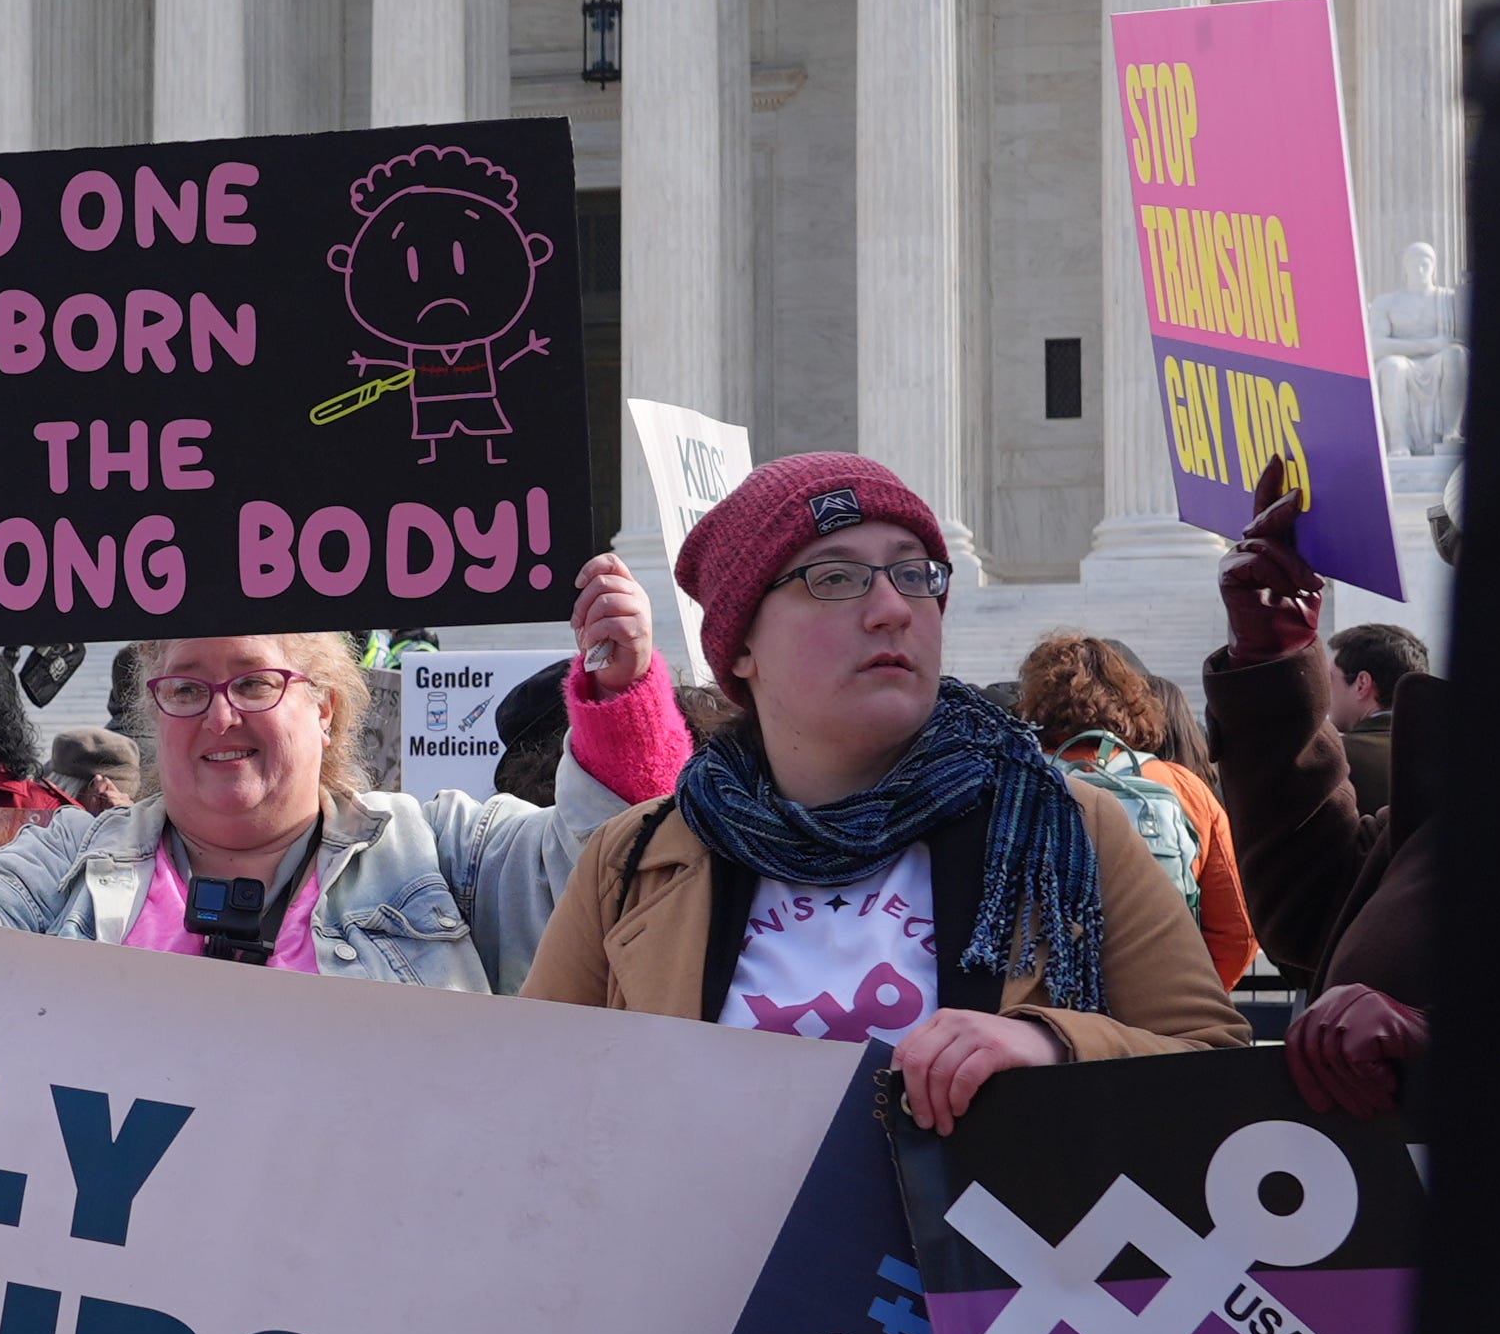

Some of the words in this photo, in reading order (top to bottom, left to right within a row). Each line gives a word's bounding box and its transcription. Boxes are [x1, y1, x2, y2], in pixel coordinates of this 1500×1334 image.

[1125, 62, 1198, 187] STOP
[60, 161, 260, 252] ONE
[1140, 203, 1301, 349] TRANSING
[33, 418, 216, 493] THE
[675, 434, 729, 503] KIDS'
[1164, 355, 1231, 486] GAY
[1225, 369, 1311, 513] KIDS
[238, 485, 552, 599] BODY!
[415, 666, 495, 689] Gender
[408, 735, 500, 757] Medicine
